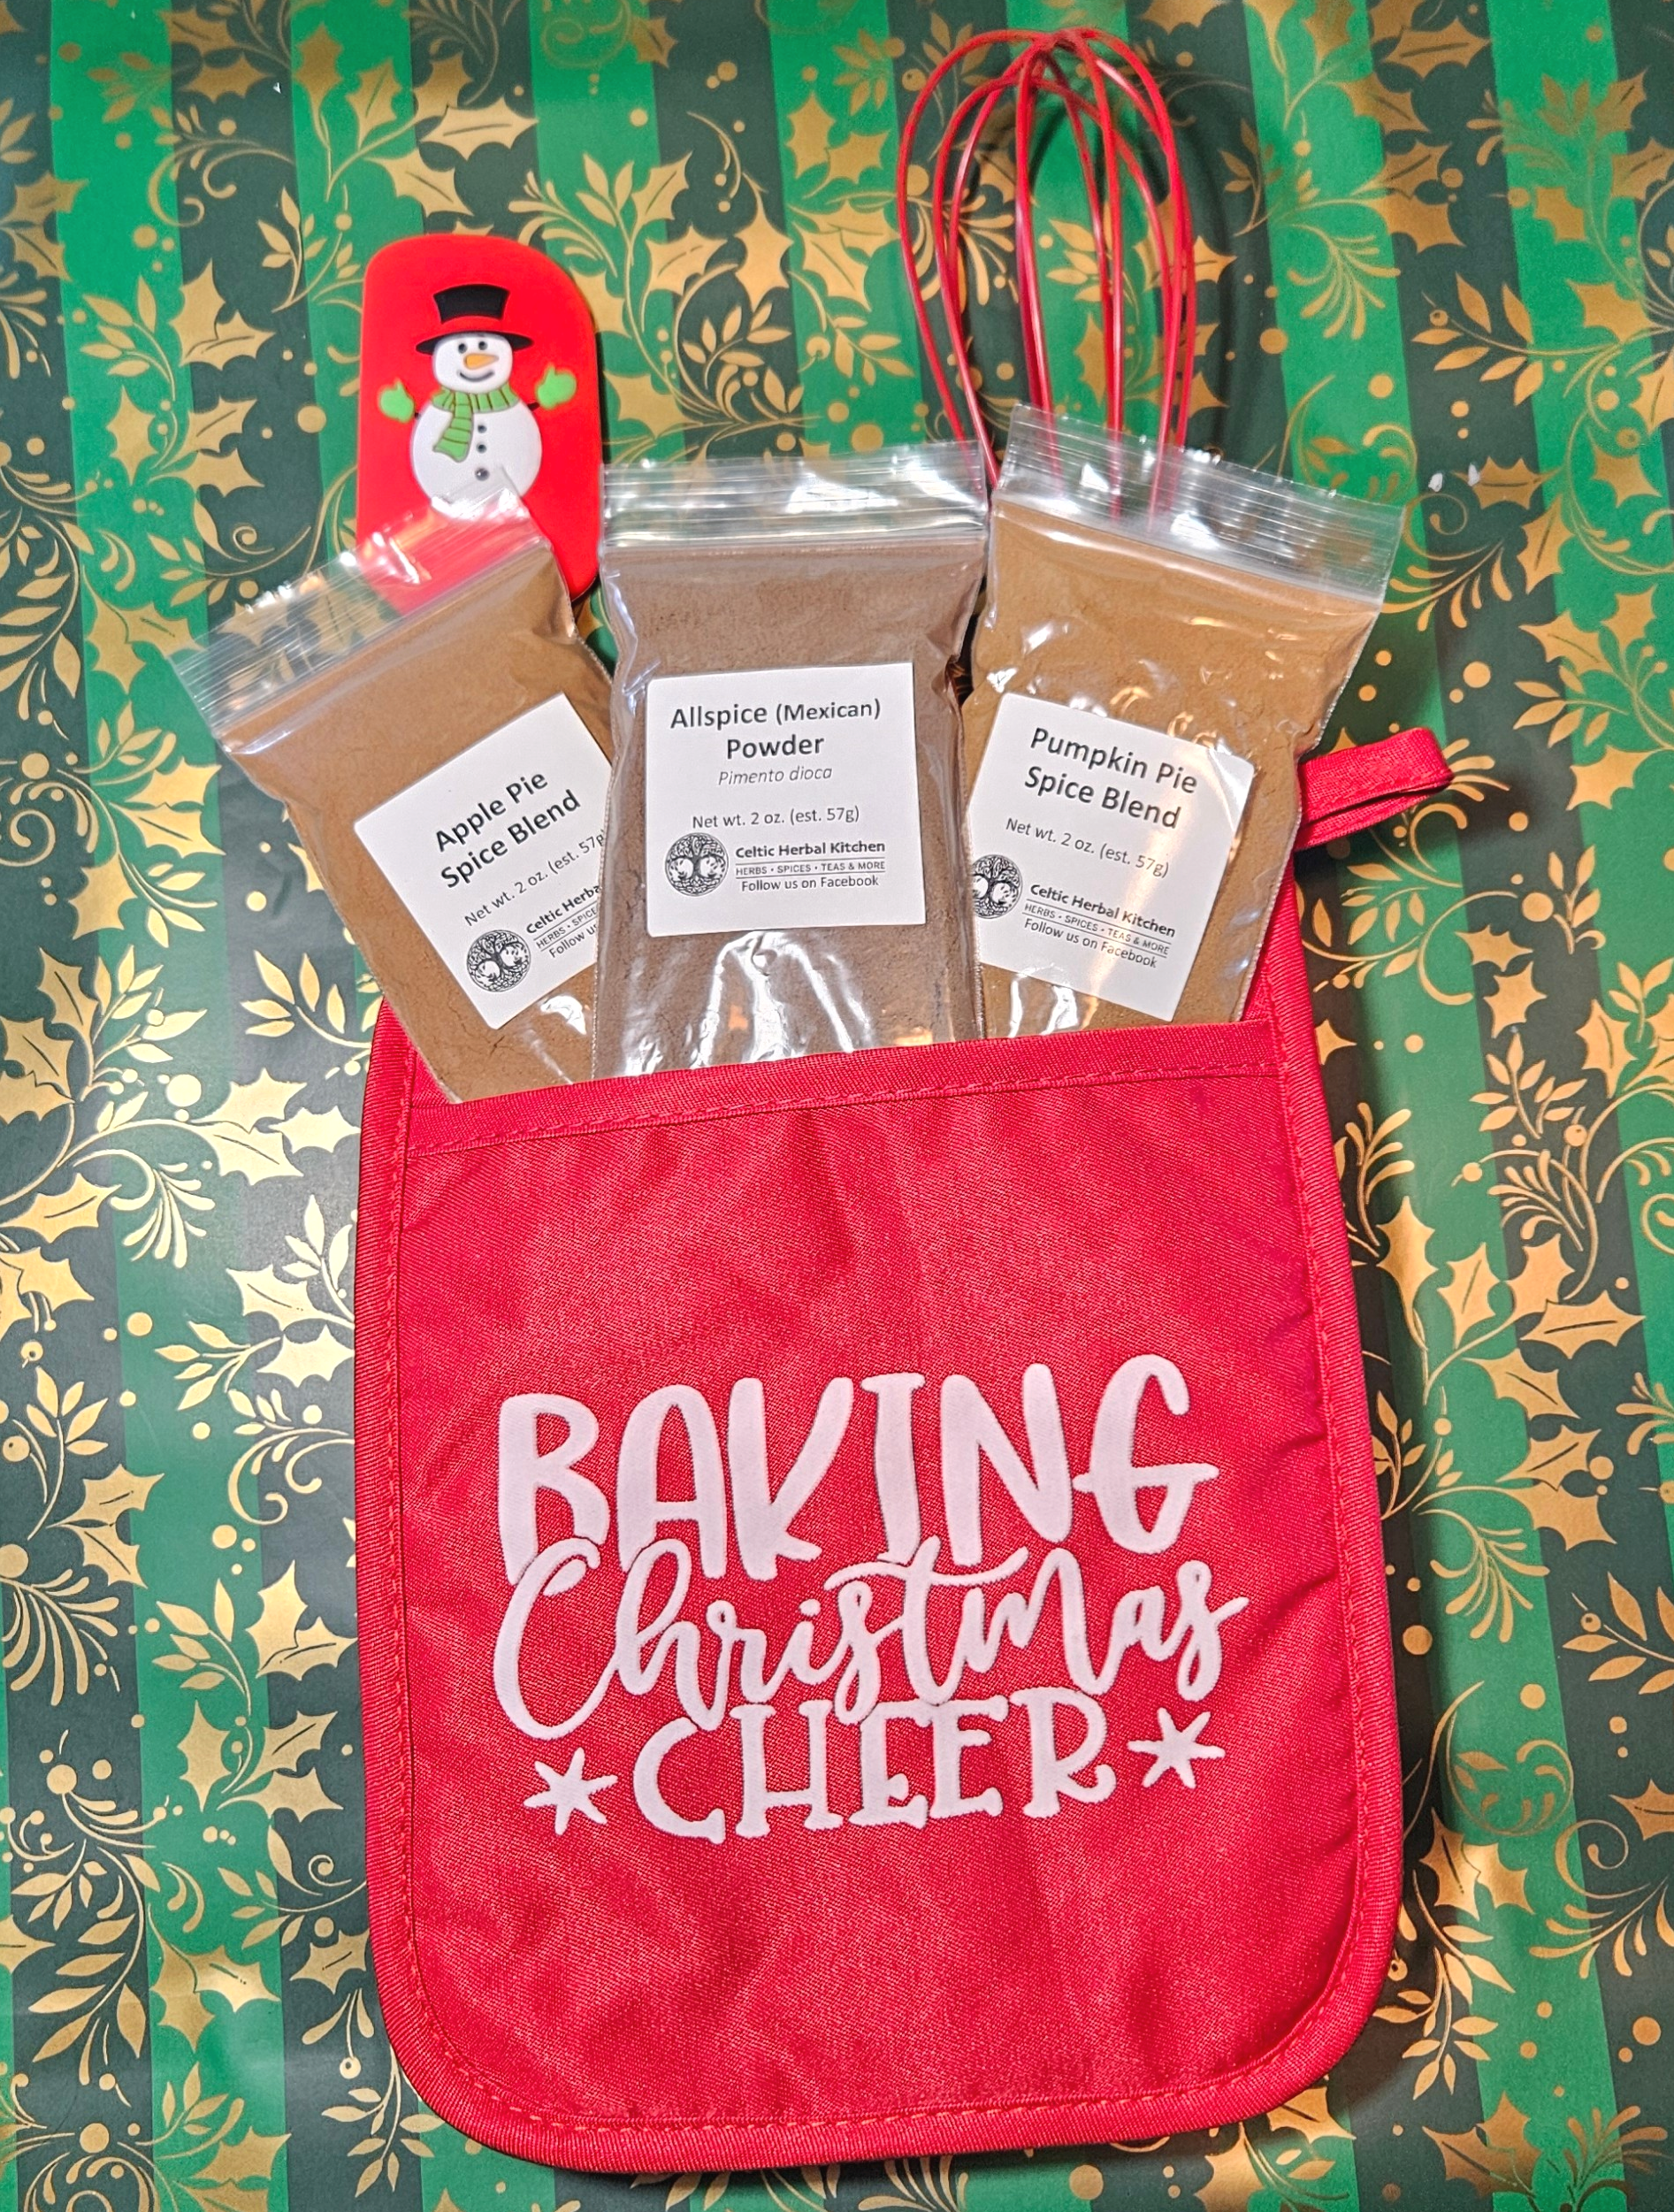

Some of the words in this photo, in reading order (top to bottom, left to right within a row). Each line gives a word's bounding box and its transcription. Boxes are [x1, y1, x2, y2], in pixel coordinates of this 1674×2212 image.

[670, 703, 767, 731] Allspice
[776, 699, 881, 726] (Mexican)
[727, 735, 824, 759] Powder
[1030, 727, 1149, 778] Pumpkin
[1156, 762, 1198, 793] Pie
[718, 769, 784, 785] Pimento
[790, 766, 832, 781] dioca
[1024, 766, 1095, 804] Spice
[1102, 786, 1181, 829] Blend
[436, 800, 506, 852] Apple
[506, 771, 548, 804] Pie
[692, 815, 718, 828] Net
[723, 814, 745, 827] wt.
[751, 812, 759, 824] 2
[764, 813, 784, 823] oz.
[790, 807, 822, 825] (est.
[827, 806, 860, 823] 57g)
[440, 837, 508, 888] Spice
[508, 789, 580, 846] Blend
[735, 846, 774, 858] Celtic
[779, 844, 826, 855] Herbal
[830, 840, 885, 853] Kitchen
[1005, 817, 1031, 836] Net
[1035, 828, 1056, 843] wt.
[1060, 832, 1071, 846] 2
[1074, 838, 1096, 854] oz.
[1099, 843, 1131, 865] (est.
[1135, 854, 1169, 879] 57g)
[464, 902, 492, 927] Net
[492, 891, 515, 914] wt.
[515, 882, 527, 895] 2
[528, 870, 548, 888] oz.
[549, 849, 578, 876] (est.
[579, 830, 606, 853] 57g
[736, 866, 767, 875] HERBS
[822, 862, 845, 871] TEAS
[742, 879, 781, 892] Follow
[784, 880, 798, 890] us
[801, 879, 816, 889] on
[821, 876, 878, 887] Facebook
[526, 906, 563, 934] Celtic
[562, 885, 600, 910] Herba
[537, 926, 565, 949] HERBS
[571, 907, 599, 926] SPICE
[1024, 904, 1056, 919] HERBS
[1065, 915, 1098, 932] SPICES
[1107, 928, 1131, 943] TEAS
[1133, 934, 1140, 945] &
[1143, 938, 1169, 955] MORE
[1030, 884, 1068, 904] Celtic
[1072, 894, 1120, 920] Herbal
[1123, 909, 1175, 938] Kitchen
[549, 930, 585, 959] Follow
[1024, 918, 1064, 940] Follow
[1066, 931, 1080, 944] us
[1082, 936, 1097, 950] on
[1101, 940, 1158, 968] Facebook
[498, 1353, 1219, 1586] BAKING
[493, 1536, 1249, 1741] Christmas
[633, 1688, 1117, 1844] CHEER
